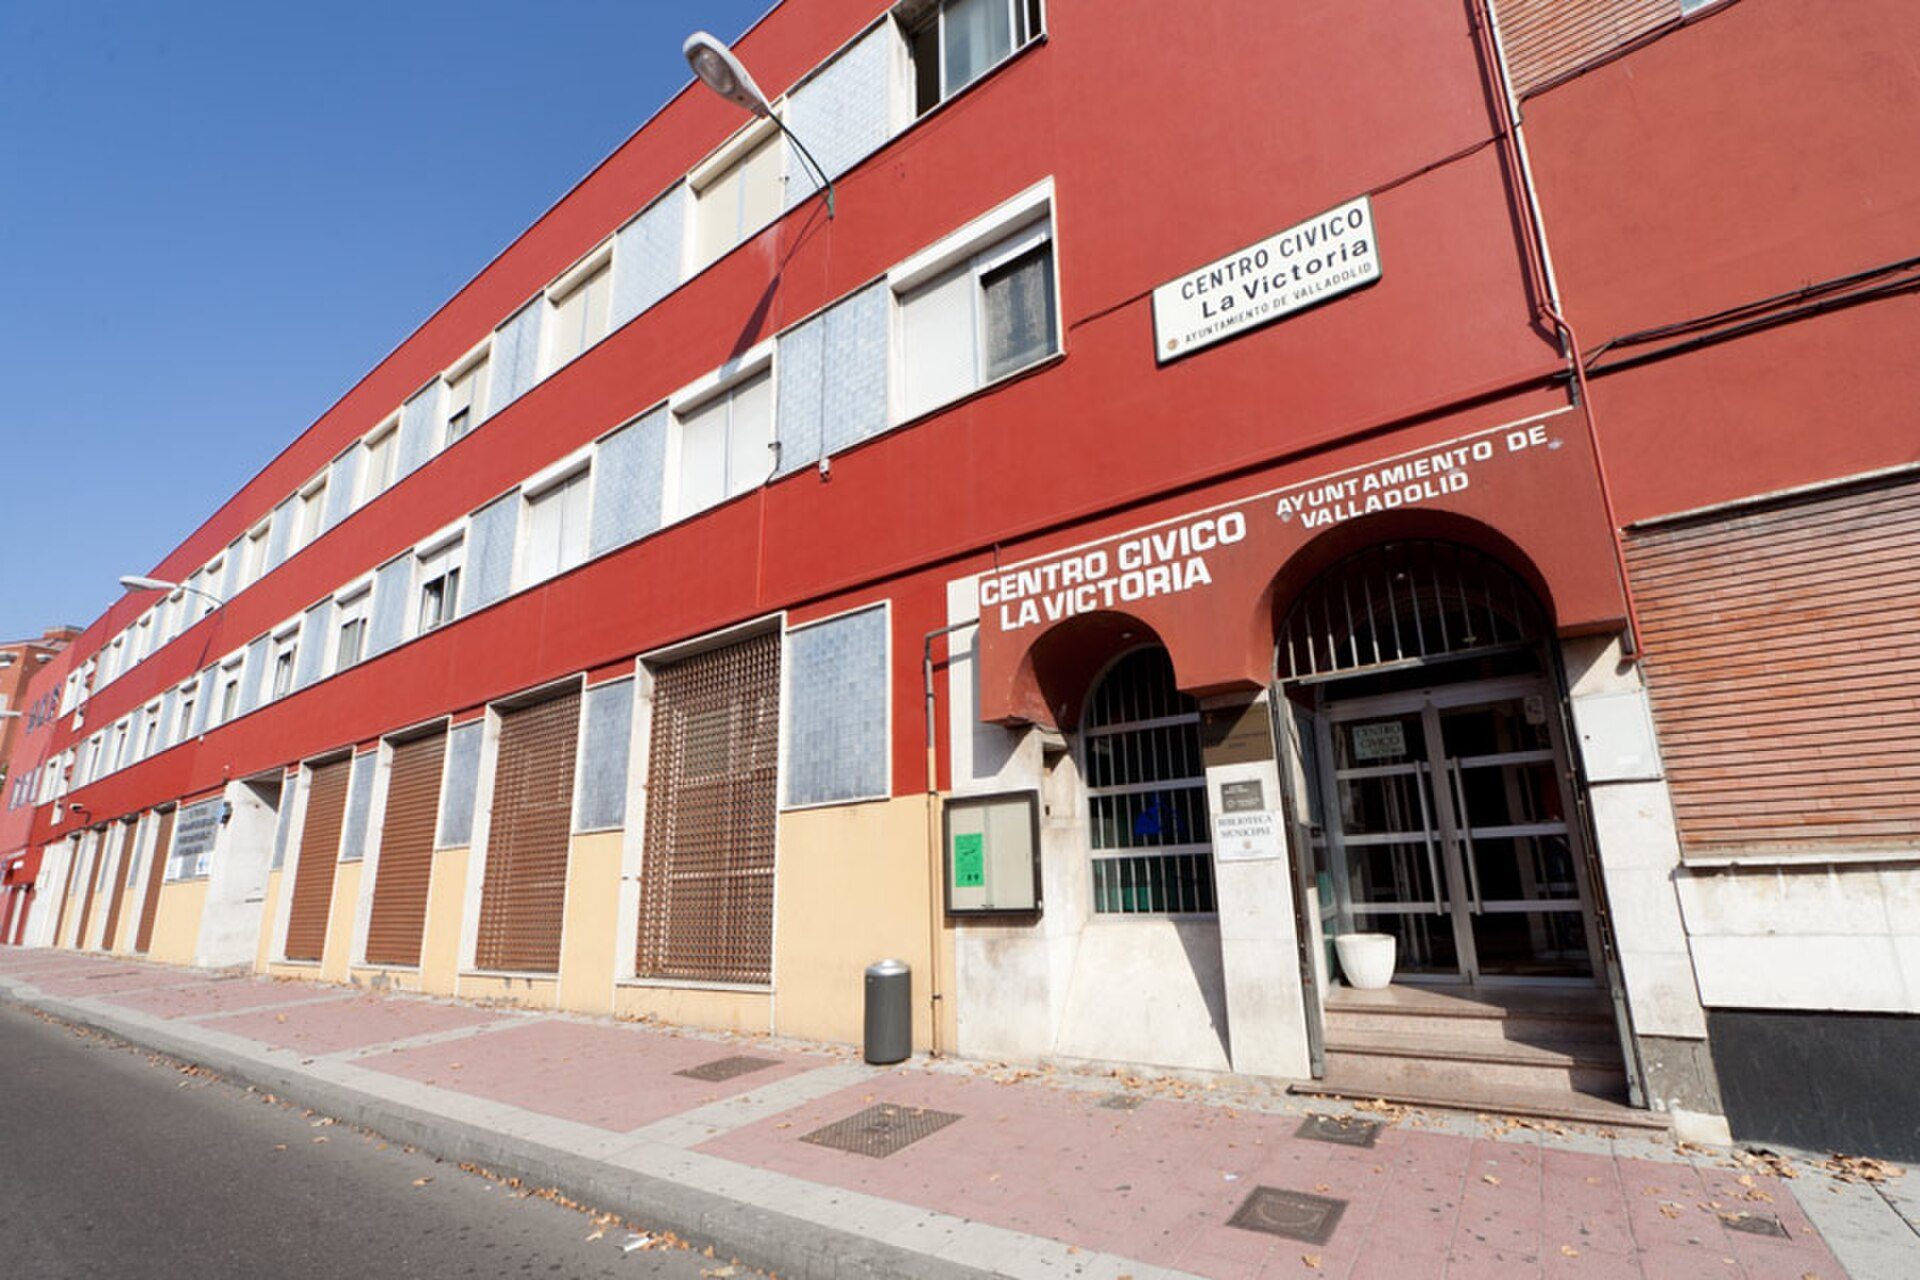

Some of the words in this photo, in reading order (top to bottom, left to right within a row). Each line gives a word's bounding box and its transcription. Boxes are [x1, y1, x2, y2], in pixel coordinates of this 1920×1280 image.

[1181, 249, 1269, 300] CENTRO
[1279, 208, 1363, 258] CIVICO
[1202, 295, 1235, 319] La
[1242, 239, 1368, 300] Victoria
[1185, 303, 1269, 343] AYUNTAMIENTO
[1273, 298, 1287, 311] DE
[1293, 262, 1372, 300] VALLADOLID
[1275, 441, 1493, 516] AYUNTAMIENTO
[1506, 425, 1548, 452] DE
[1300, 472, 1469, 529] VALLADOLID
[980, 549, 1109, 607] CENTRO
[1117, 511, 1247, 572] CIVICO
[1000, 597, 1041, 631] LA
[1042, 556, 1212, 622] VICTORIA
[1218, 815, 1272, 826] BIBLIOTECA
[1220, 827, 1270, 838] MUNICIPAL
